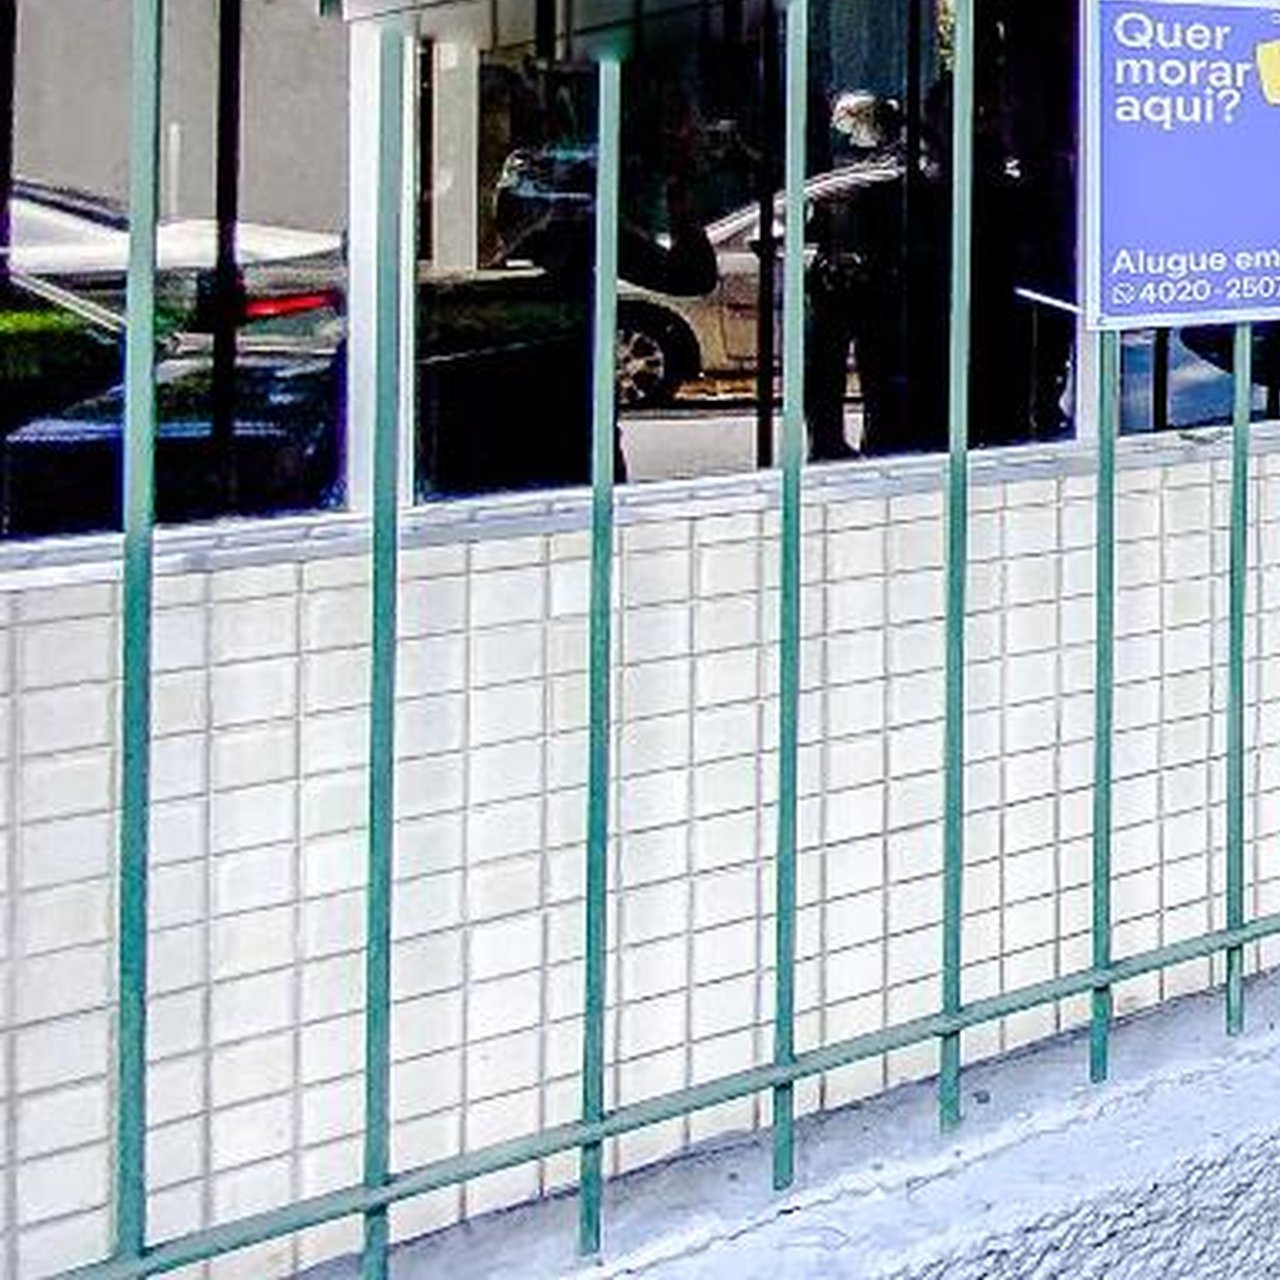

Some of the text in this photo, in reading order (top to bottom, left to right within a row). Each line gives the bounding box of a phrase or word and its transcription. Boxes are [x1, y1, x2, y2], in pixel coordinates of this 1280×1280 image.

[1113, 12, 1231, 51] Quer
[1114, 57, 1253, 88] morar
[1115, 88, 1241, 129] aqui?
[1112, 248, 1227, 279] Alugue
